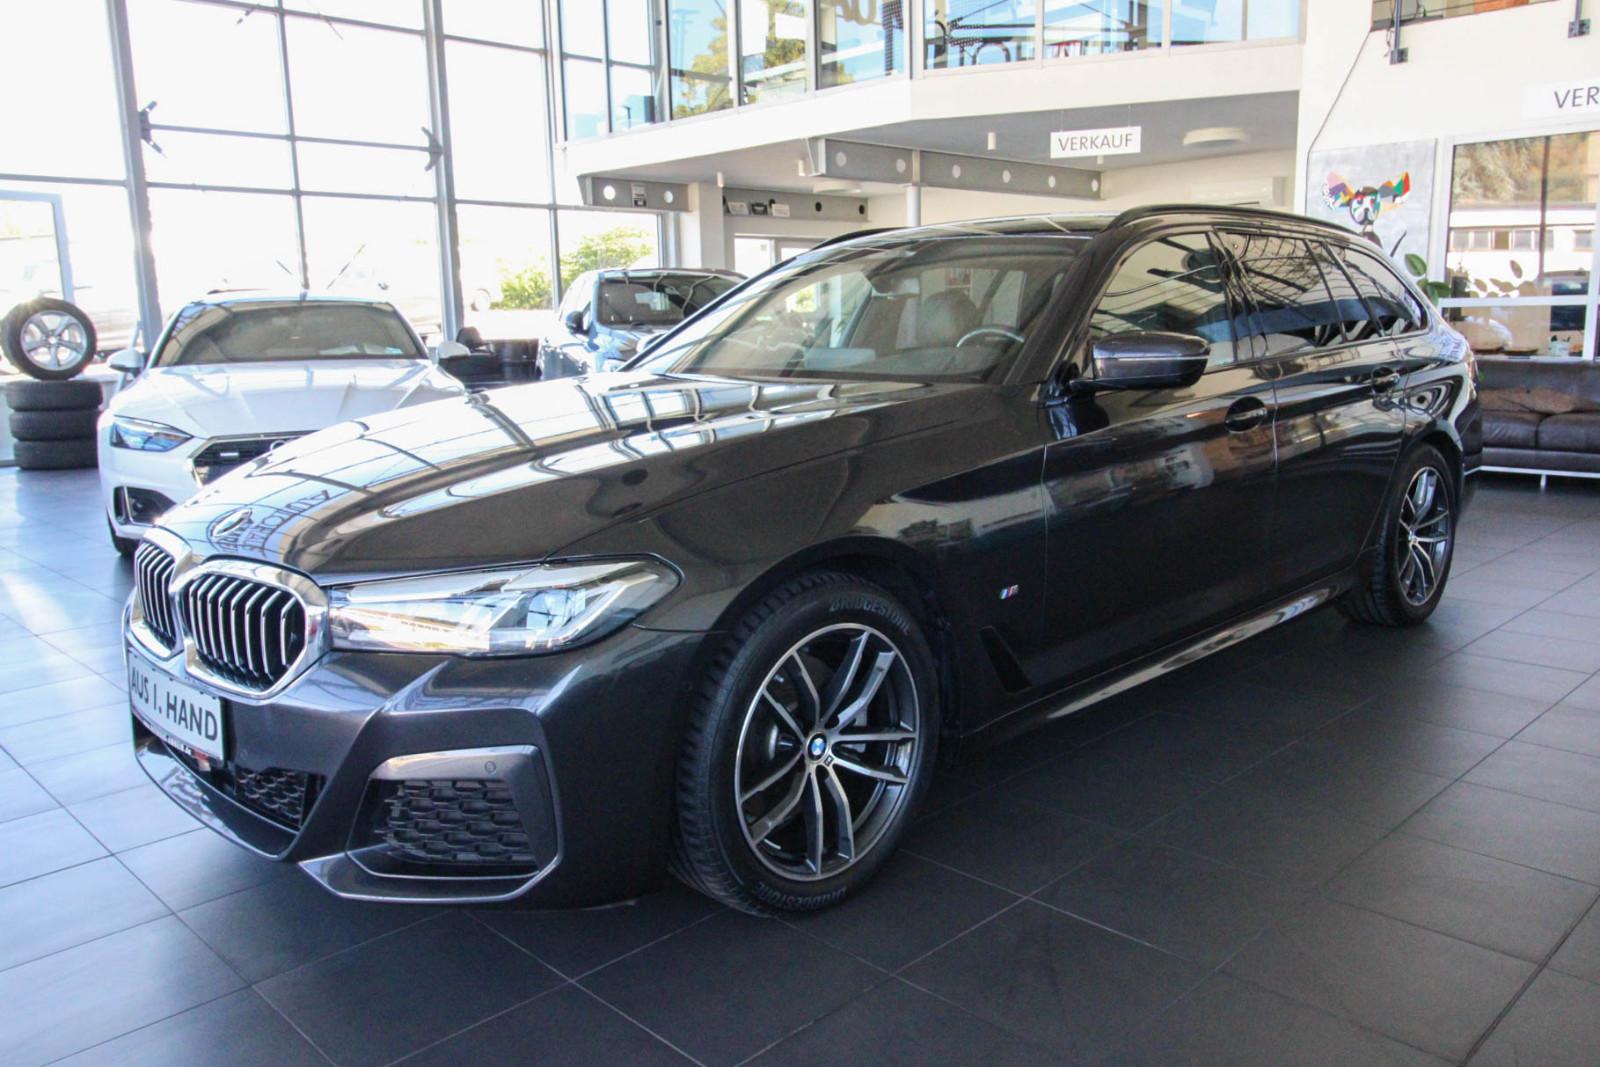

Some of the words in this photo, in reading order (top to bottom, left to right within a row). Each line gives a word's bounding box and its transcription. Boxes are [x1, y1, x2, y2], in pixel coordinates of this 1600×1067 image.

[1554, 86, 1600, 109] VER
[1058, 133, 1133, 151] VERKAUF
[131, 667, 149, 704] AUS
[166, 691, 218, 741] HAND
